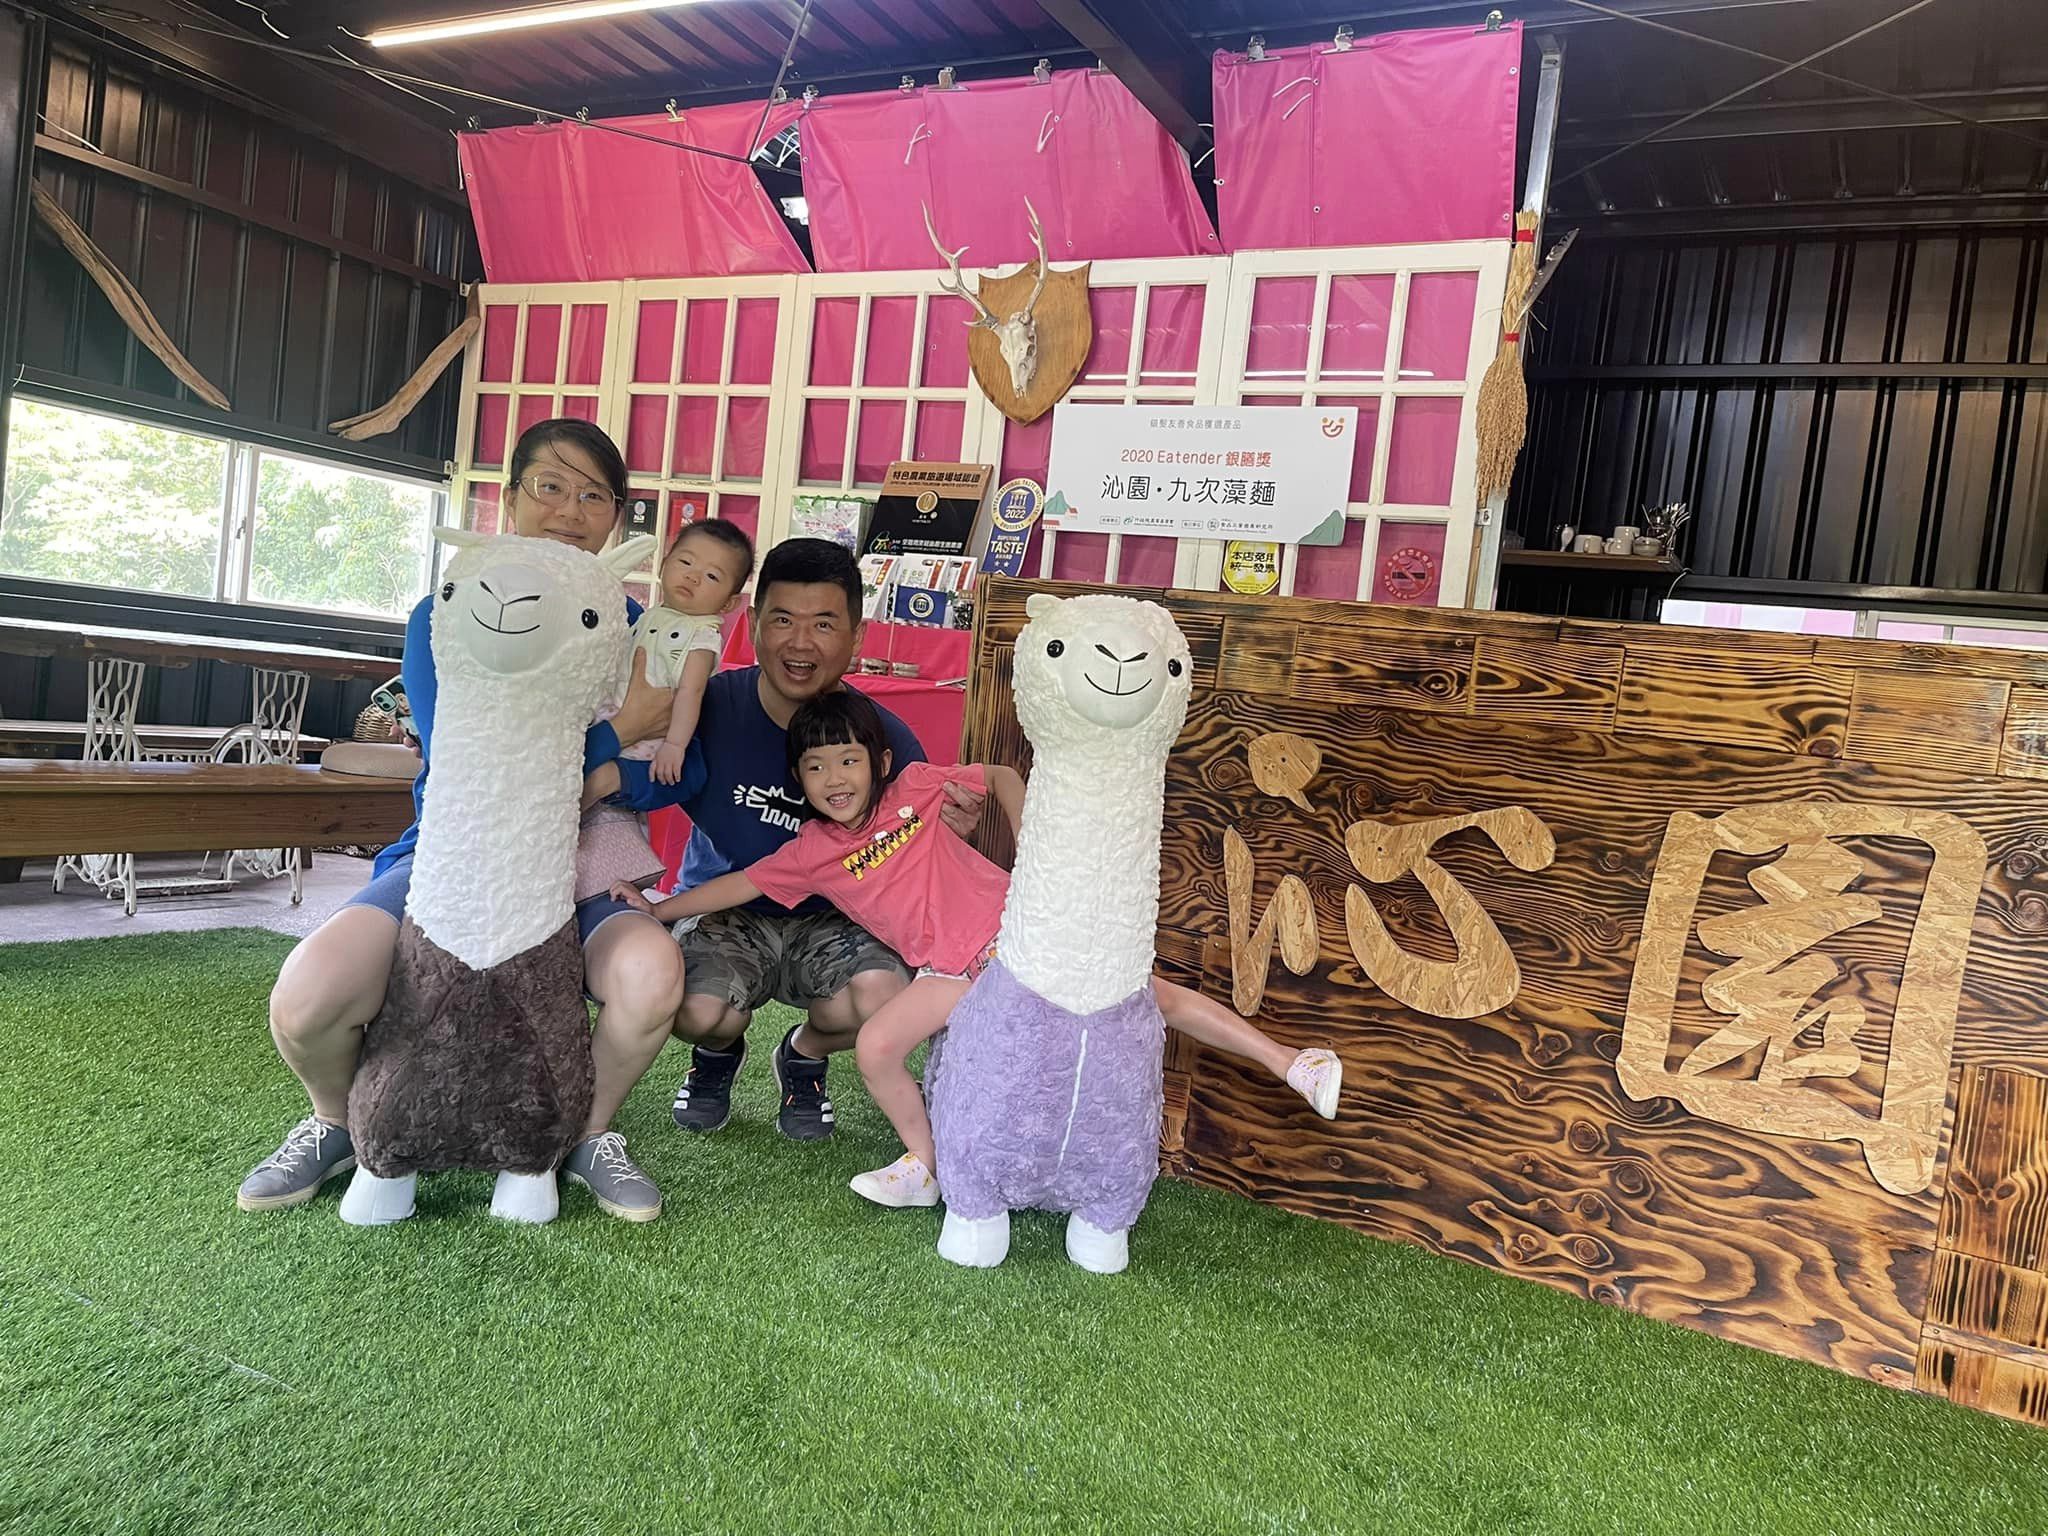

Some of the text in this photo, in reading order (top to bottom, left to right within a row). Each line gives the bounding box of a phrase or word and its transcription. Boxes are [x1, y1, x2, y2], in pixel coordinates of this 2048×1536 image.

[1121, 449, 1272, 468] 2020 Eatender 銀膳獎
[1004, 509, 1026, 519] 2022
[990, 540, 1024, 554] TASTE
[1231, 551, 1274, 562] 本店免用
[1230, 562, 1275, 573] 統一發票
